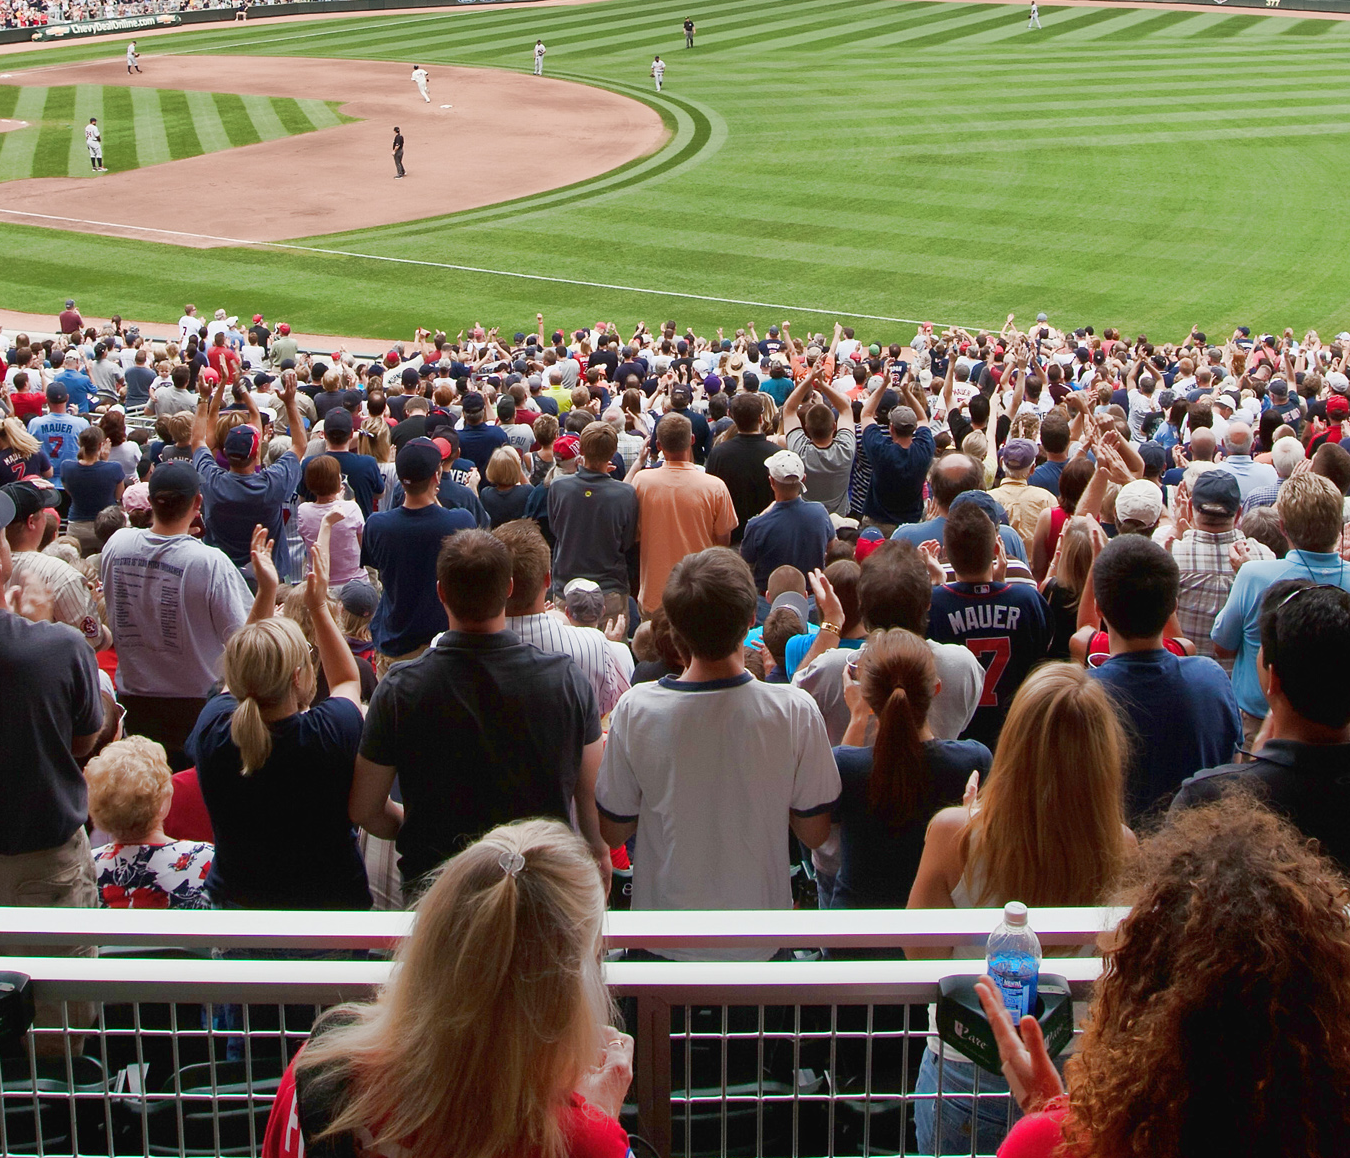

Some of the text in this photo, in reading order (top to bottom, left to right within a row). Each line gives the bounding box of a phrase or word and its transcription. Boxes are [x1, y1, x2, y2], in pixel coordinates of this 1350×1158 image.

[1265, 0, 1281, 7] 377
[41, 424, 73, 434] MAUER
[48, 437, 64, 458] 7
[12, 463, 26, 482] 7
[947, 604, 1020, 634] MAUER
[965, 636, 1010, 707] 7
